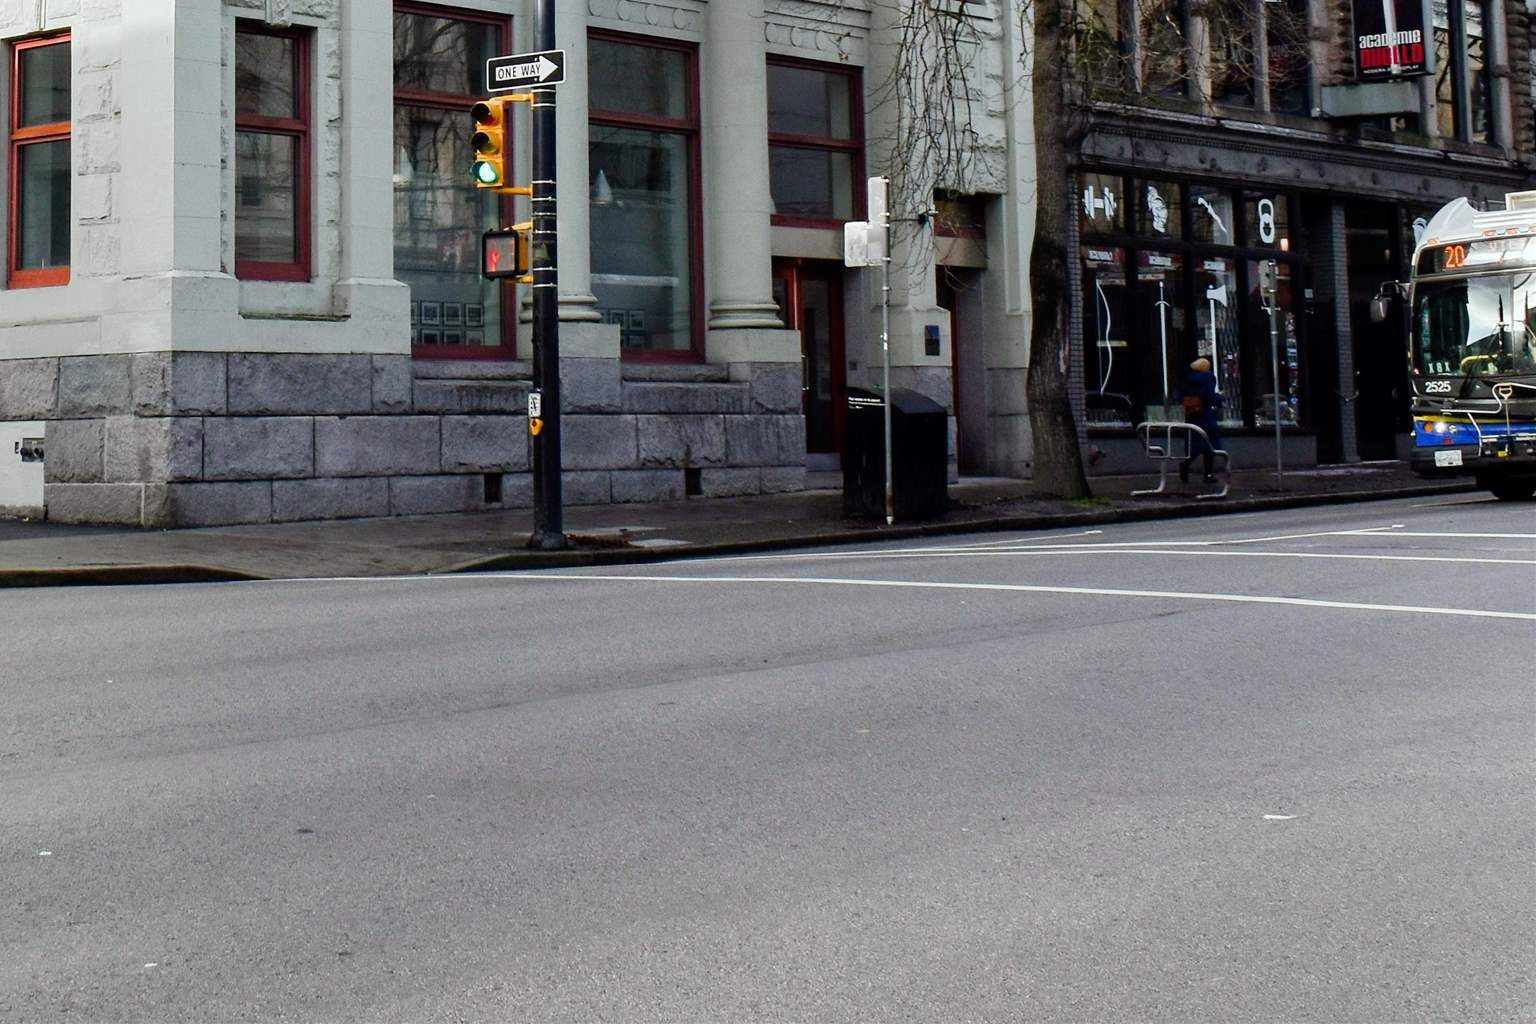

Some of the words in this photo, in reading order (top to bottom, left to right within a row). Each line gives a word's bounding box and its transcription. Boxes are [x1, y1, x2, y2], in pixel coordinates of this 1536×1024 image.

[498, 66, 517, 80] ONE
[521, 63, 541, 77] WAY
[1444, 245, 1465, 269] 20
[1425, 381, 1451, 393] 2525
